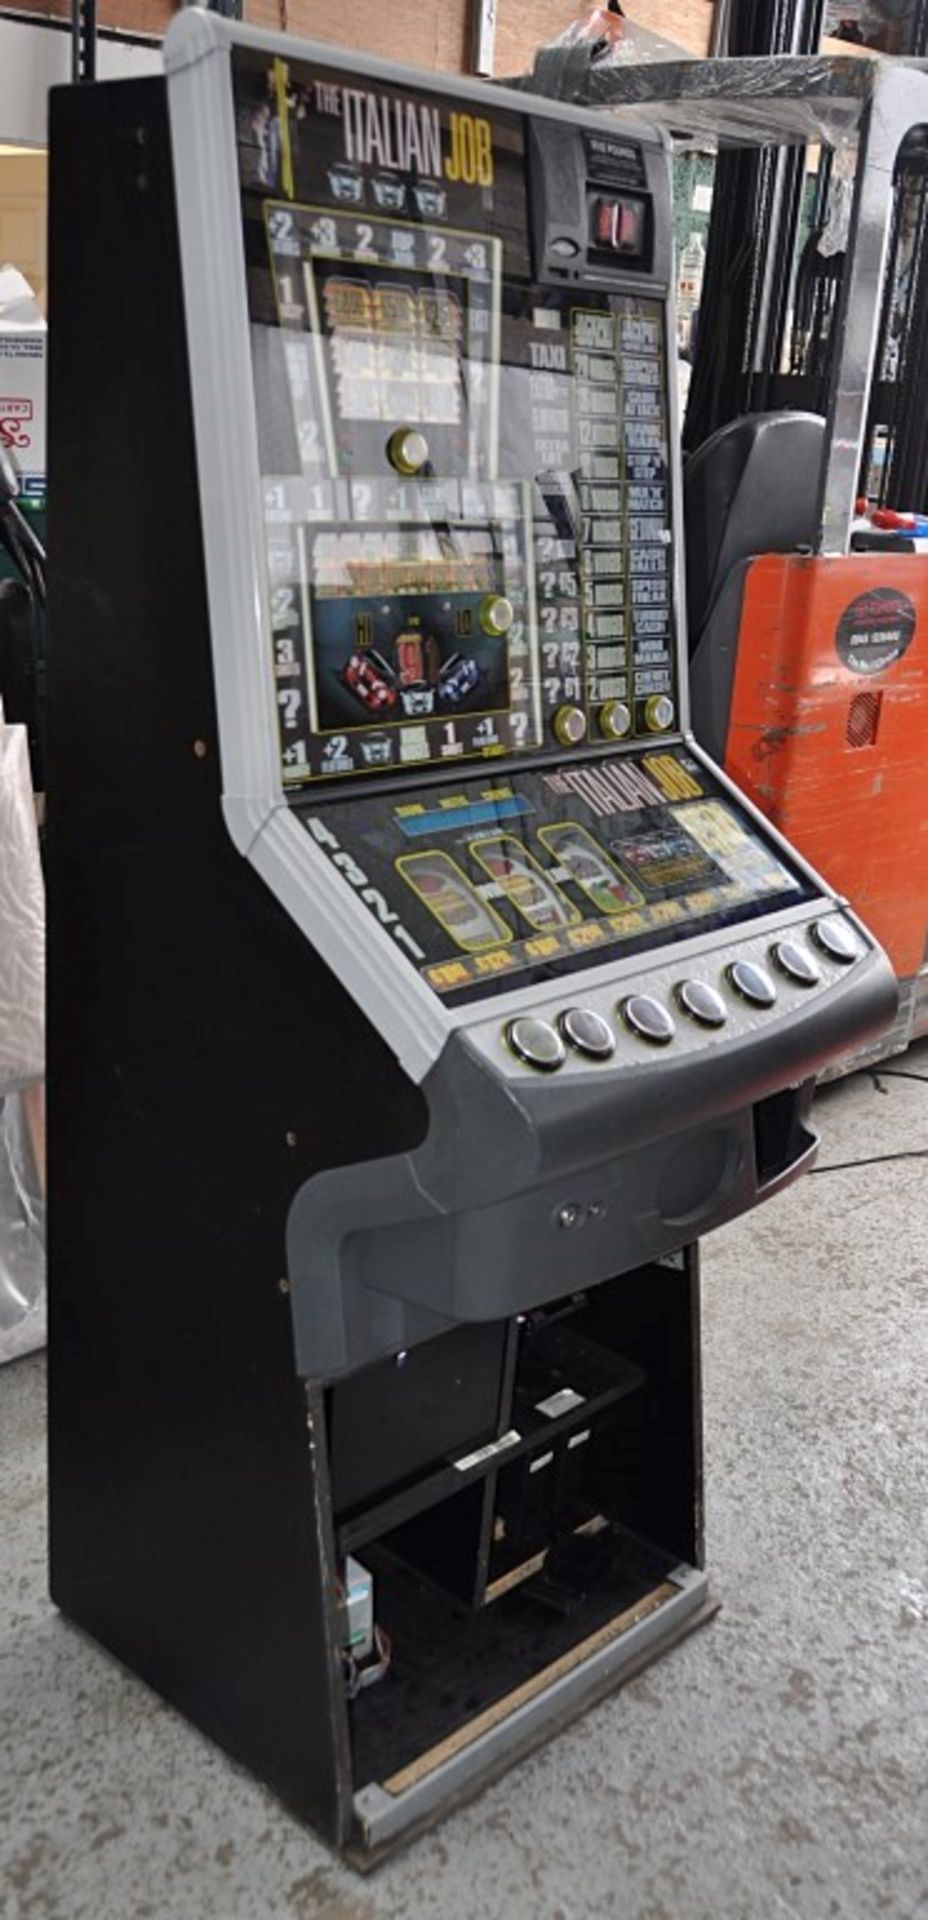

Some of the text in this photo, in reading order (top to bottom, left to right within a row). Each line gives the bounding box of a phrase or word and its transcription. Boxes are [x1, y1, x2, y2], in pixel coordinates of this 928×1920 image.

[313, 81, 494, 187] THE ITALIAN JOB
[356, 223, 374, 250] 2
[529, 341, 567, 370] TAXI
[540, 571, 556, 598] ?
[540, 606, 558, 633] ?
[542, 642, 559, 668] ?
[544, 677, 561, 703] ?
[277, 689, 300, 728] ?
[322, 735, 347, 762] +2
[442, 721, 456, 744] 1
[508, 712, 526, 746] ?
[561, 761, 666, 818] ITALIAN
[641, 754, 703, 801] JOB
[306, 816, 340, 849] 4
[332, 851, 369, 886] 3
[361, 887, 399, 923] 2
[394, 924, 426, 959] 1
